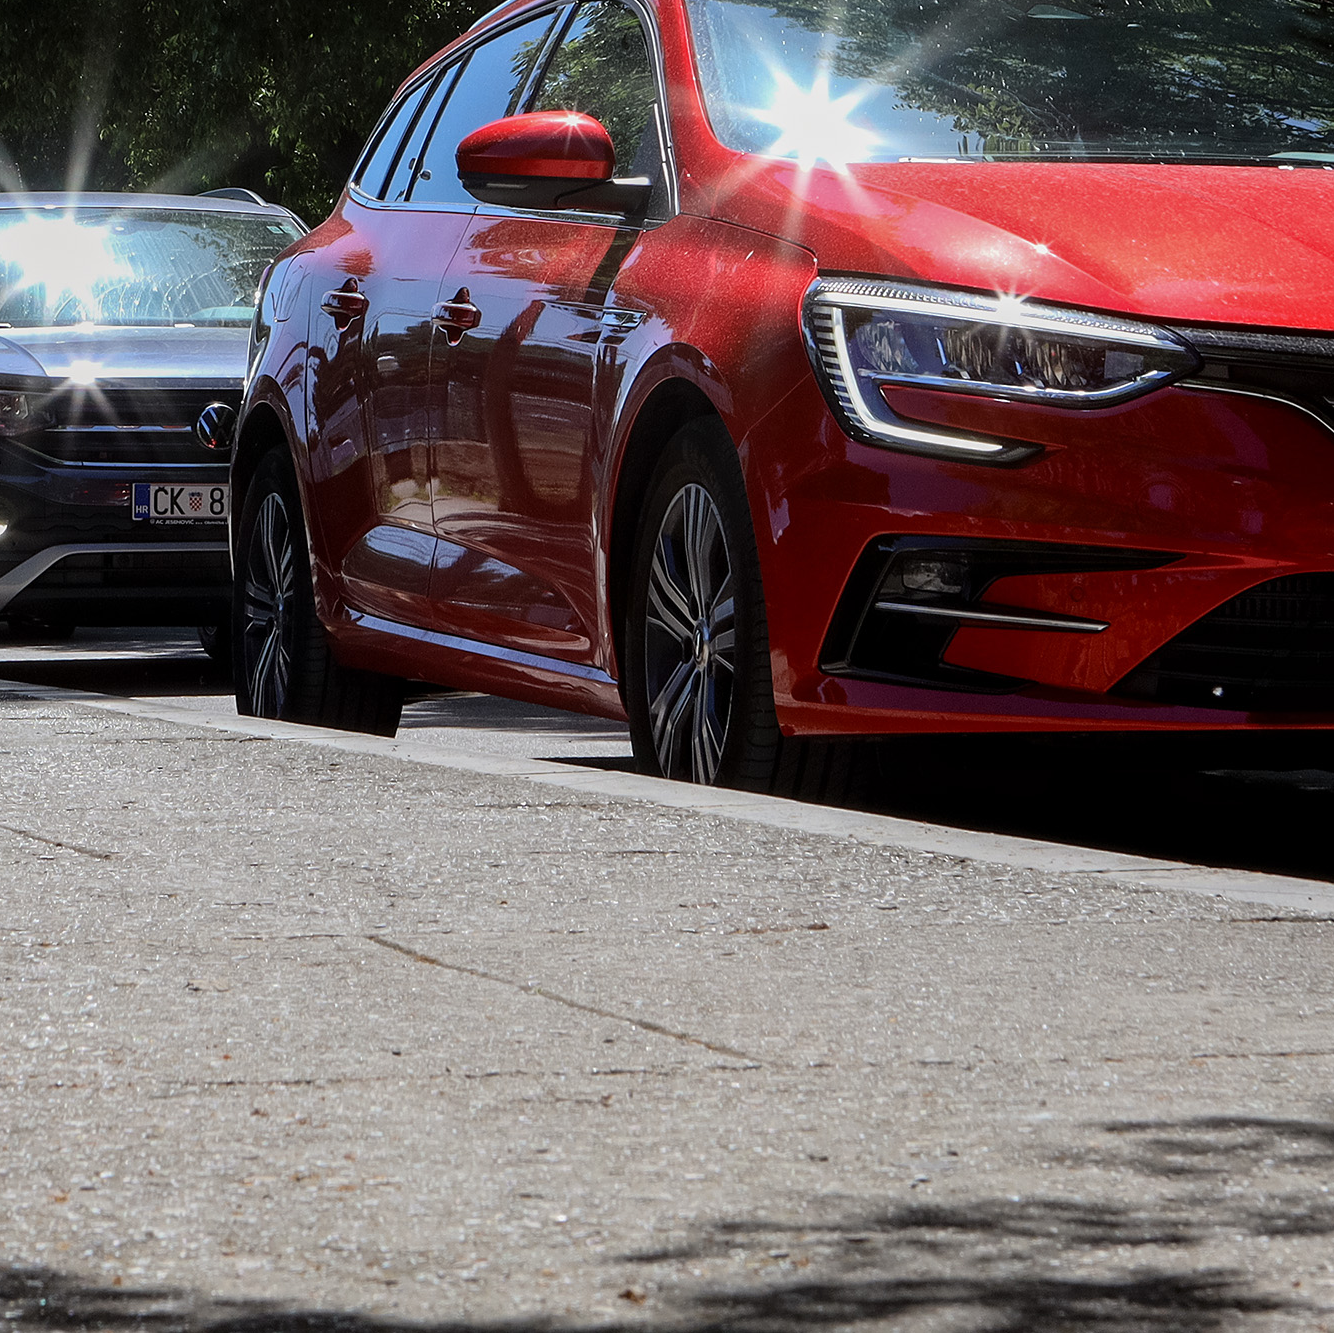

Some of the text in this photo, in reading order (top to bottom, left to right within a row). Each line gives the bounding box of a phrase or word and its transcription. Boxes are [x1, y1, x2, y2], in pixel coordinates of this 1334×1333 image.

[135, 505, 149, 514] HR
[153, 487, 225, 515] ČK 8
